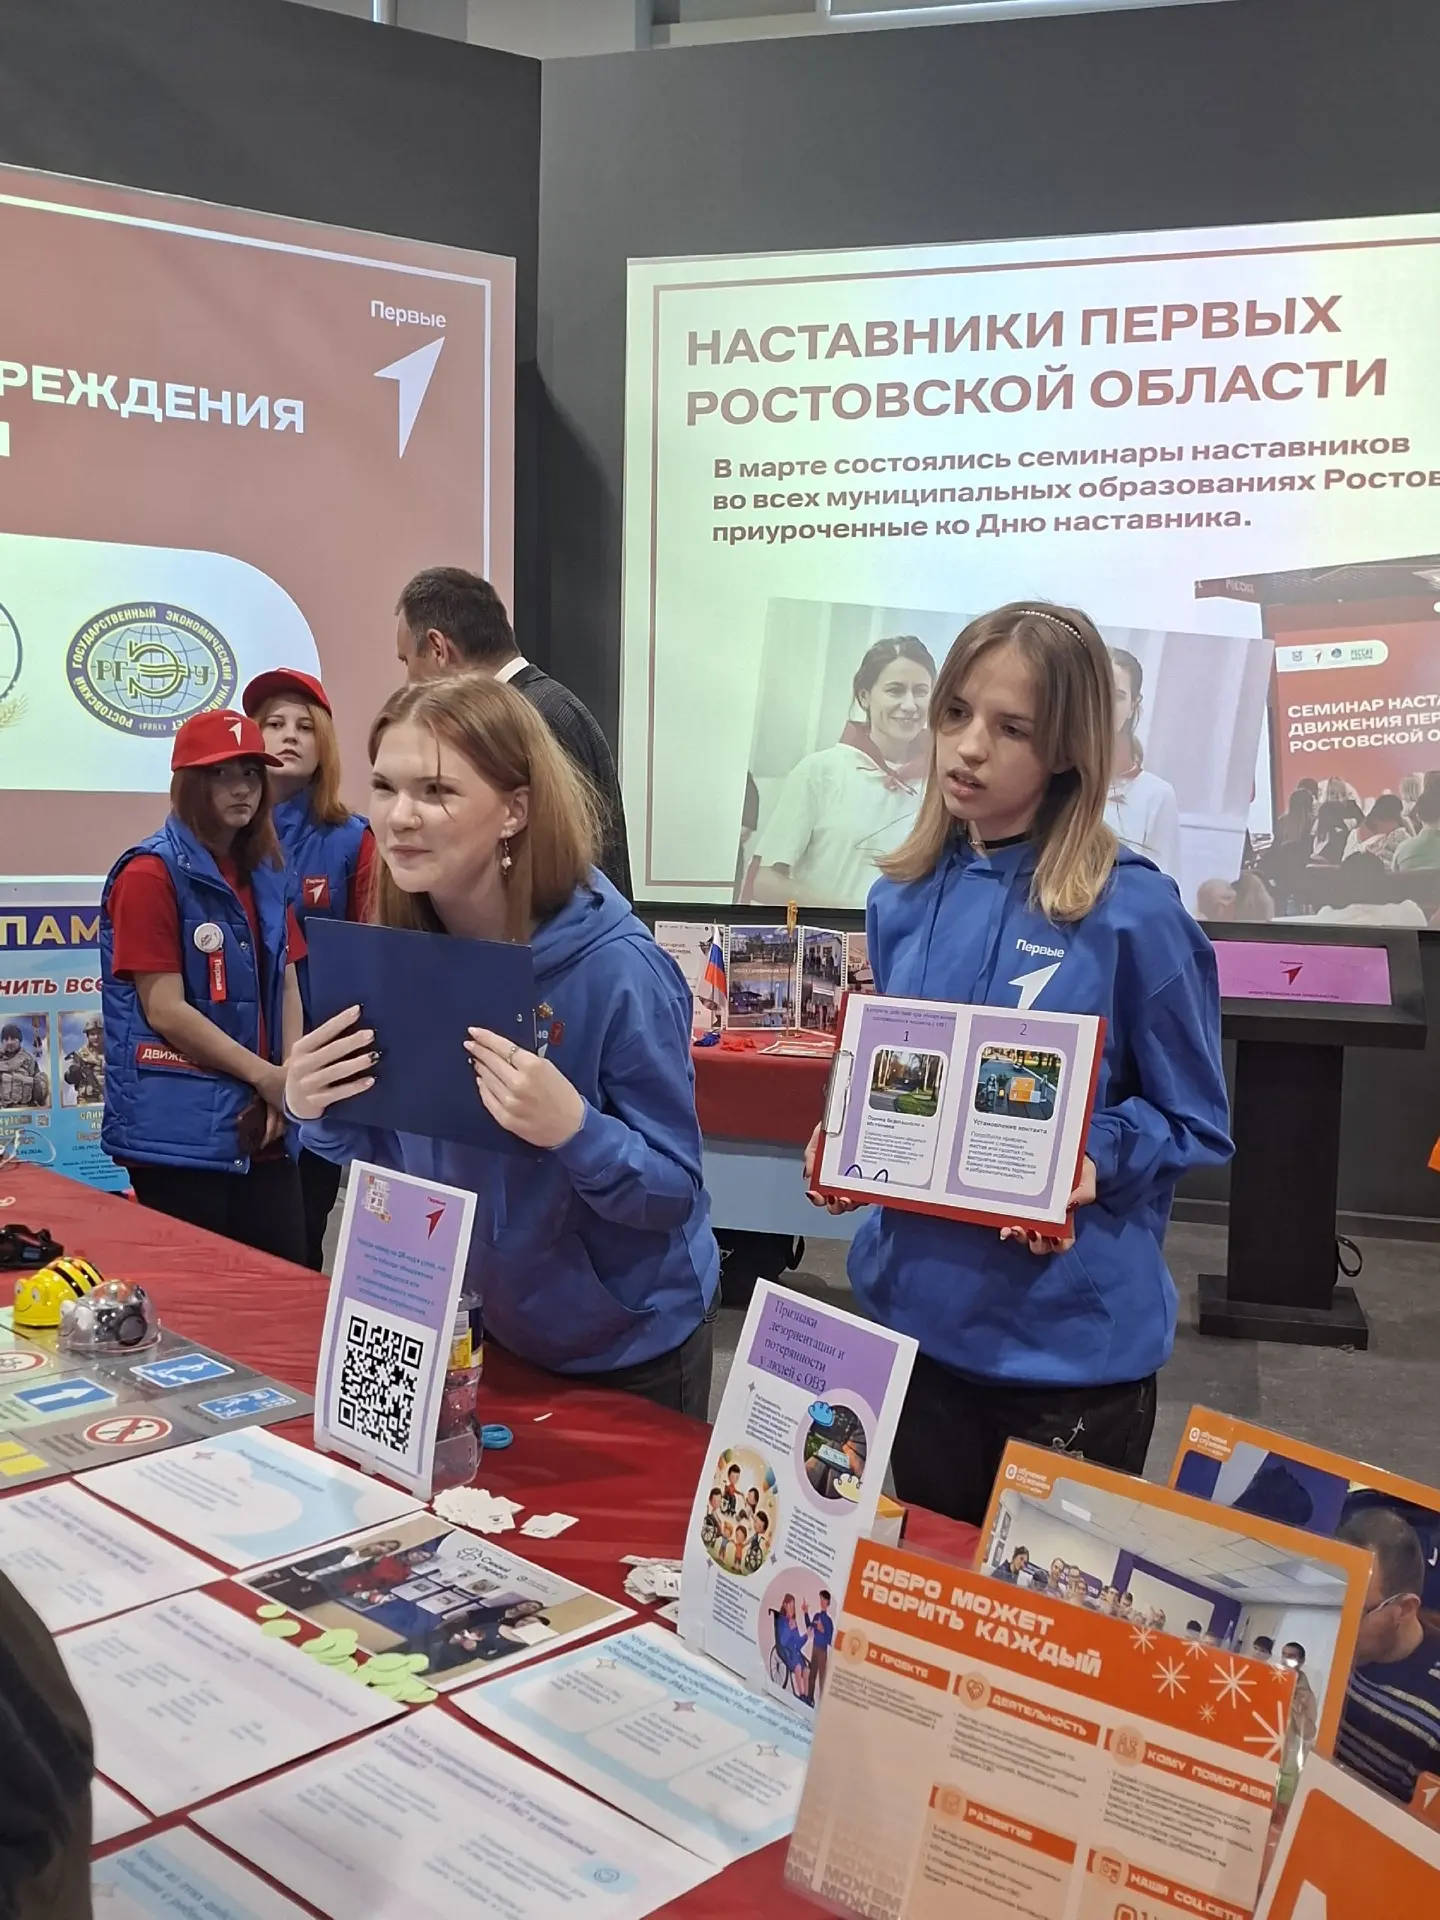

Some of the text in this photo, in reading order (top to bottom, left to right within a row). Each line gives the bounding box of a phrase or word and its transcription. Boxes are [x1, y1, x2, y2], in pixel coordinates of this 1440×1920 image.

[371, 299, 448, 329] Первые
[687, 294, 1343, 367] НАСТАВНИКИ ПЕРВЫХ
[0, 359, 305, 434] РЕЖДЕНИЯ
[686, 357, 1387, 427] РОСТОВСКОЙ ОБЛАСТИ
[714, 436, 1411, 481] В марте состоялись семинары наставников
[713, 467, 1440, 511] во всех муниципальных образованиях Ростов
[712, 509, 1252, 546] приуроченные ко Дню наставника.
[72, 605, 157, 669] ГОСУДАРСТВЕННЫЙ
[165, 609, 234, 681] ЭКОНОМИЧЕСКИЙ
[72, 675, 134, 729] РОСТОВСКИЙ
[1287, 698, 1384, 718] СЕМИНАР
[1287, 711, 1440, 738] ДВИЖЕНИЯ ПЕР
[1289, 728, 1423, 753] РОСТОВСКОЙ
[1015, 938, 1065, 958] Первые
[903, 1030, 910, 1042] 1
[1019, 1023, 1028, 1036] 2
[774, 1299, 818, 1329] Признаки
[764, 1337, 826, 1373] потерянности
[768, 1320, 846, 1361] дезориентации и
[767, 1359, 796, 1381] людей
[804, 1371, 827, 1393] ОВЗ
[861, 1559, 1055, 1636] ДОБРО МОЖЕТ
[860, 1579, 1102, 1679] ТВОРИТЬ КАЖДЫЙ
[869, 1649, 929, 1679] О ПРОЕКТЕ
[991, 1694, 1087, 1737] ДЕЯТЕЛЬНОСТЬ
[1147, 1750, 1272, 1802] КОМУ ПОМОГАЕМ
[967, 1807, 1033, 1843] РАЗВИТИЕ
[824, 1863, 903, 1913] МОЖЕМ
[1130, 1873, 1169, 1896] НАШИ
